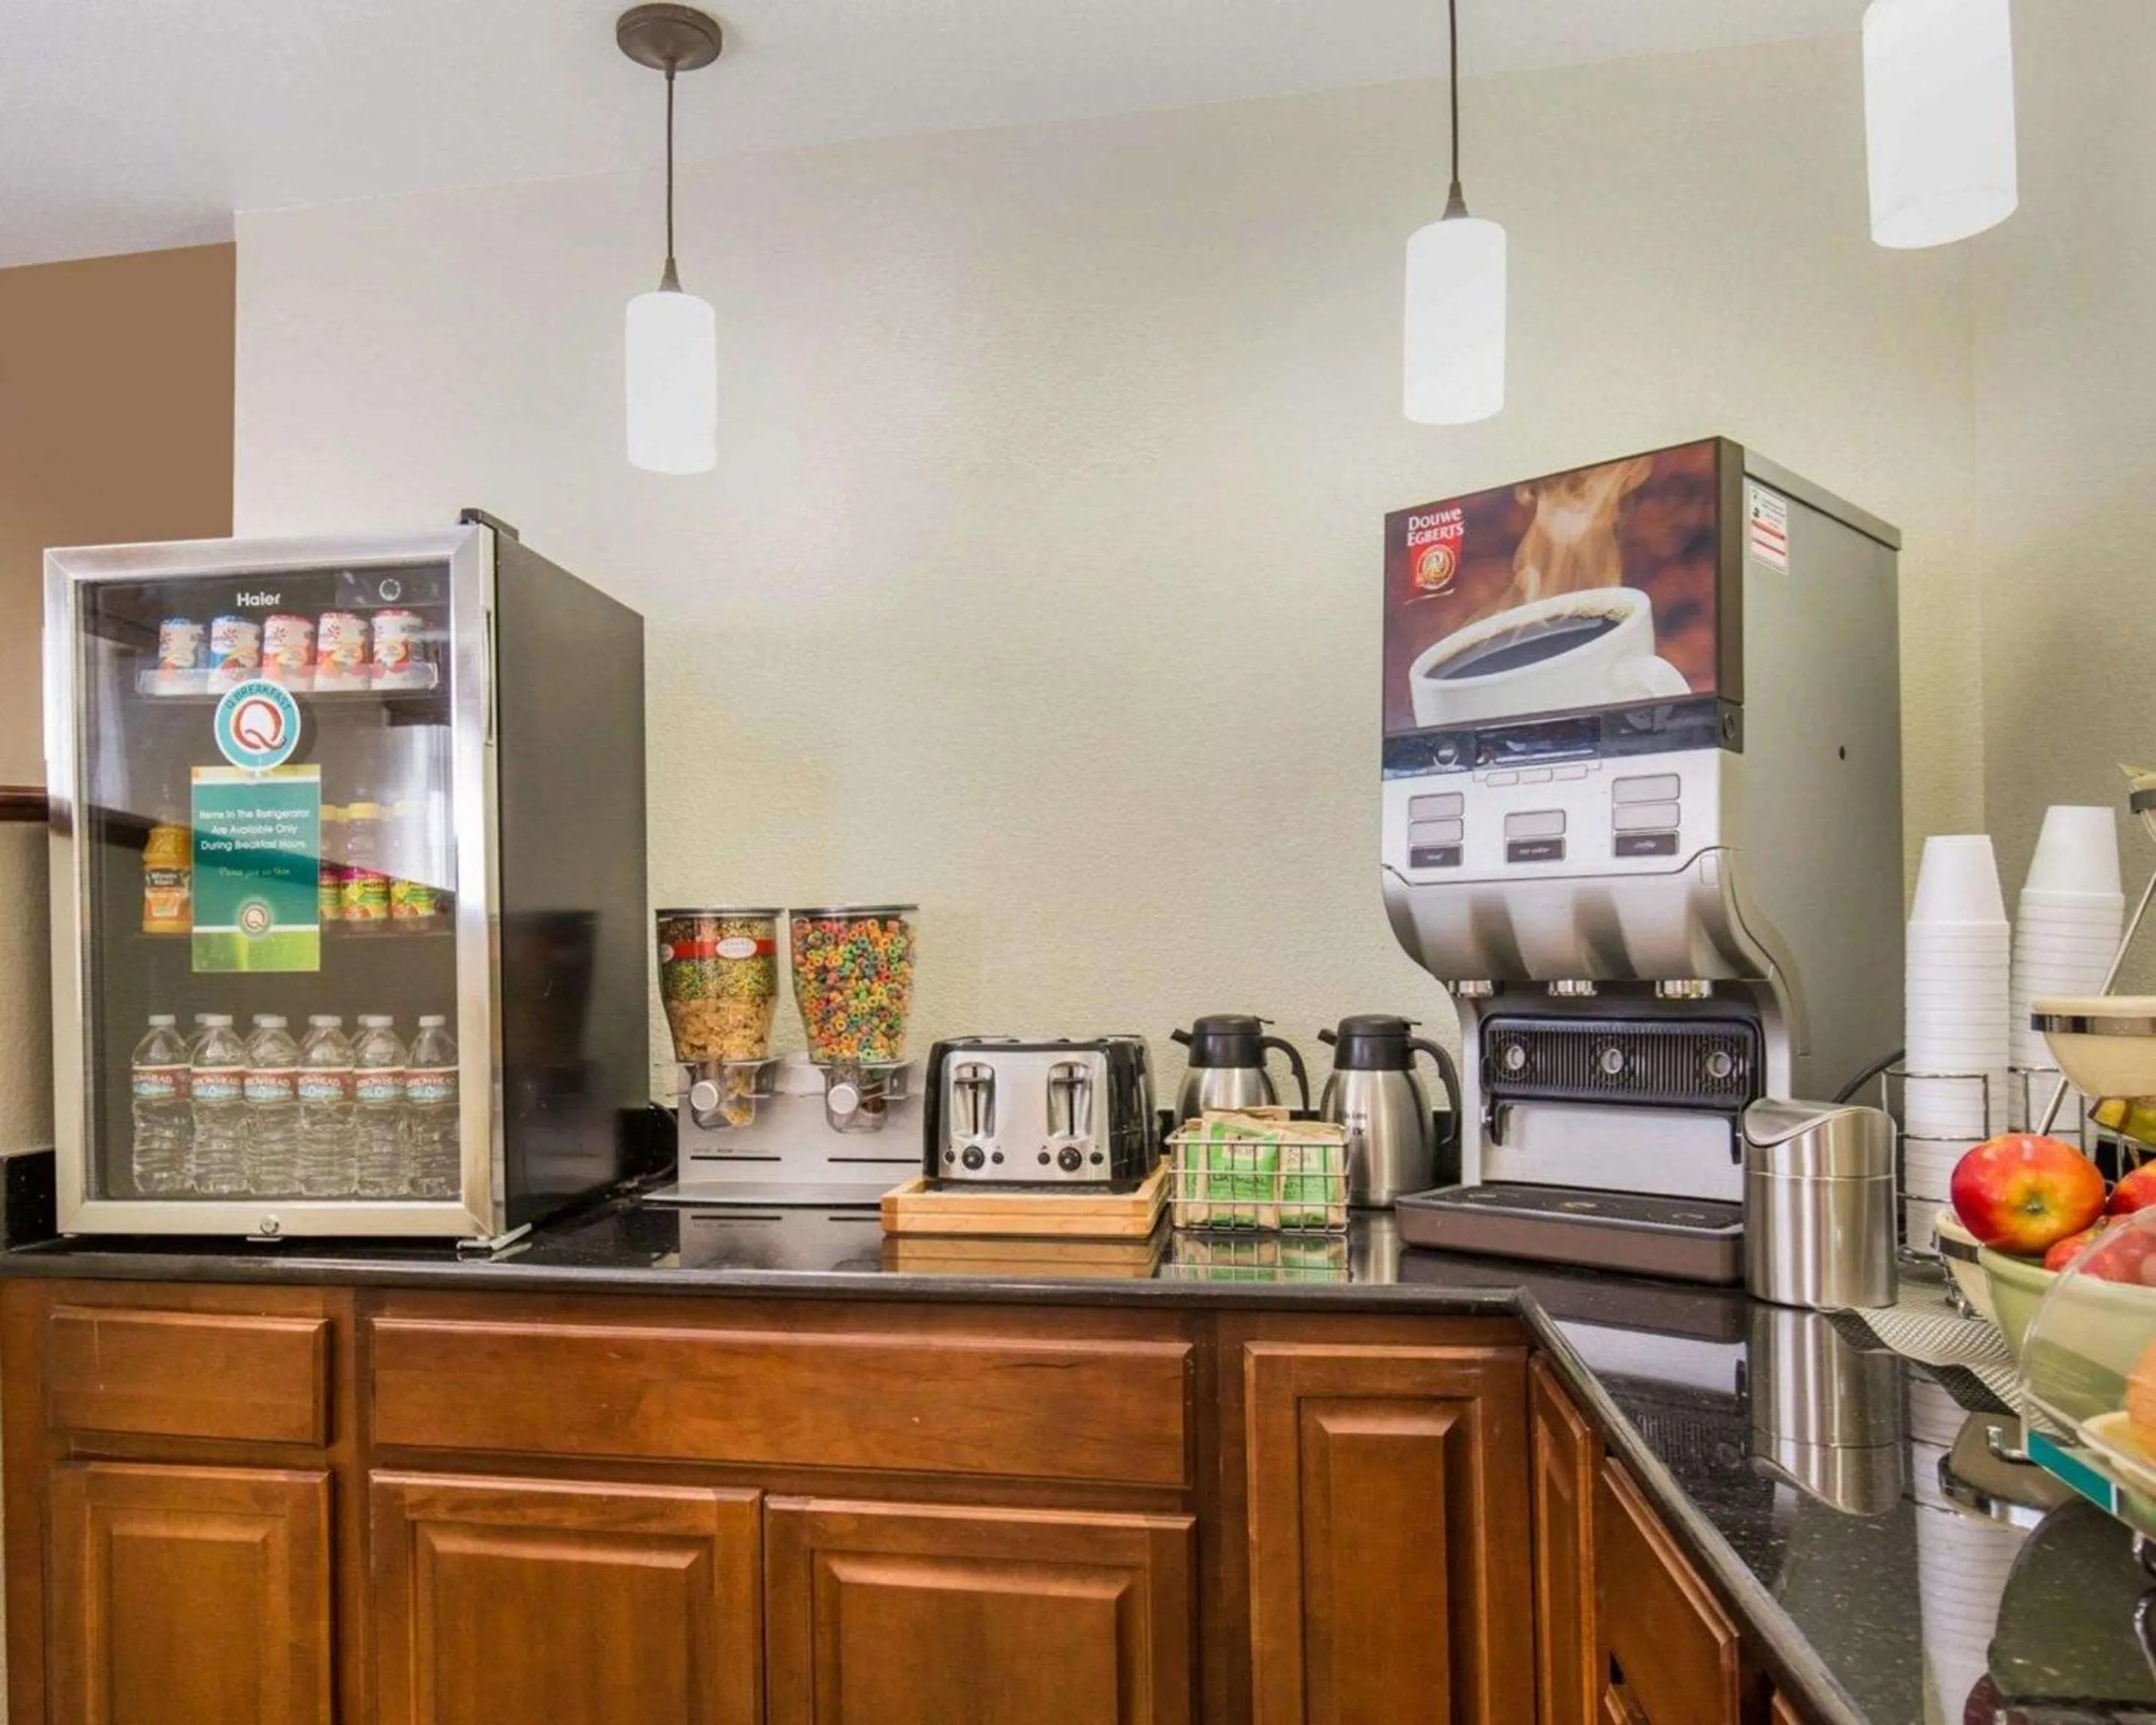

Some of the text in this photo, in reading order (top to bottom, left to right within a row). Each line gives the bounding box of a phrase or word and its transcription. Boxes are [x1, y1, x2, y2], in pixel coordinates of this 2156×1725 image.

[1407, 521, 1464, 547] EGBERTS
[237, 591, 281, 607] Haier
[233, 683, 291, 711] BREAKFAST
[199, 810, 224, 819] Items
[237, 809, 253, 818] The
[255, 809, 310, 820] Refrigerator
[211, 824, 298, 836] Are Available Only
[201, 841, 233, 851] During
[234, 840, 277, 849] Breakfast
